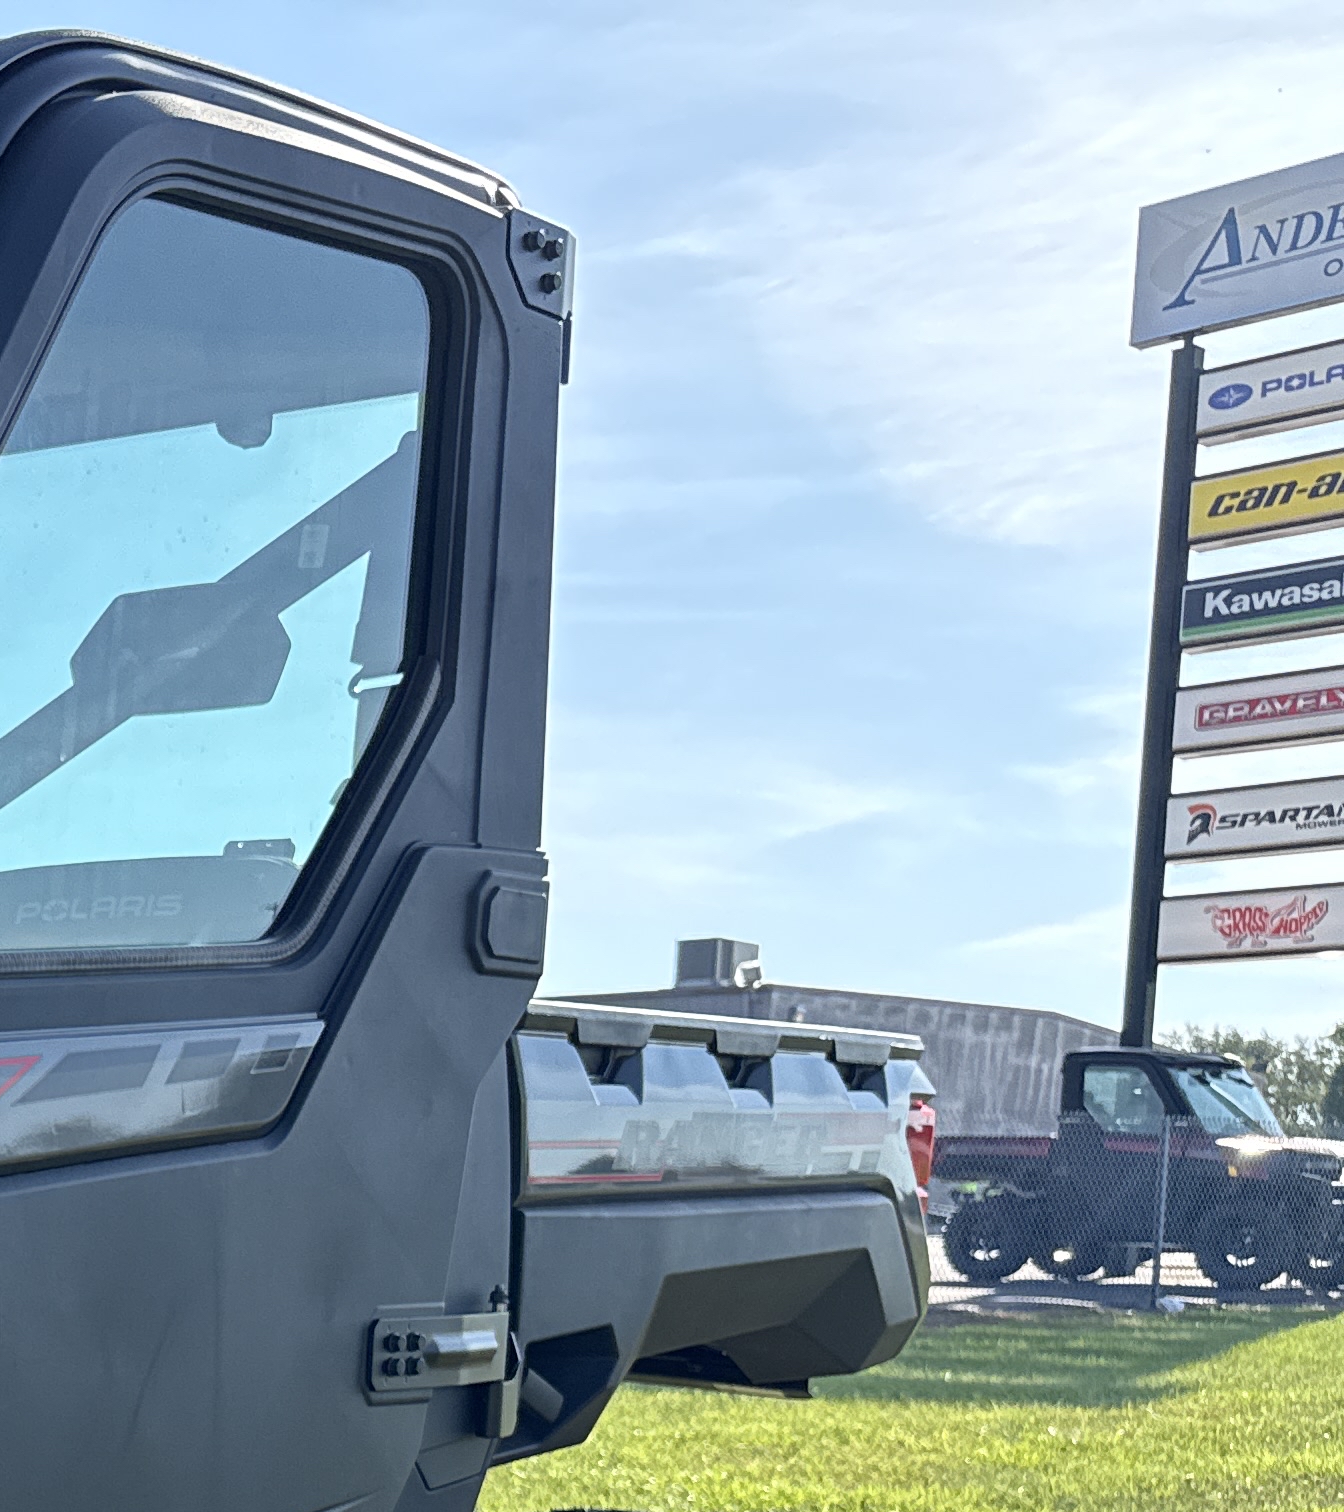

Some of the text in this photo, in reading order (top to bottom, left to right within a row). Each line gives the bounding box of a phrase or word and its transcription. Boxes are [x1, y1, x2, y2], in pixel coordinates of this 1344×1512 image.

[1207, 471, 1344, 518] can-a
[1204, 573, 1344, 618] Kawasa
[15, 893, 183, 925] POLARIS
